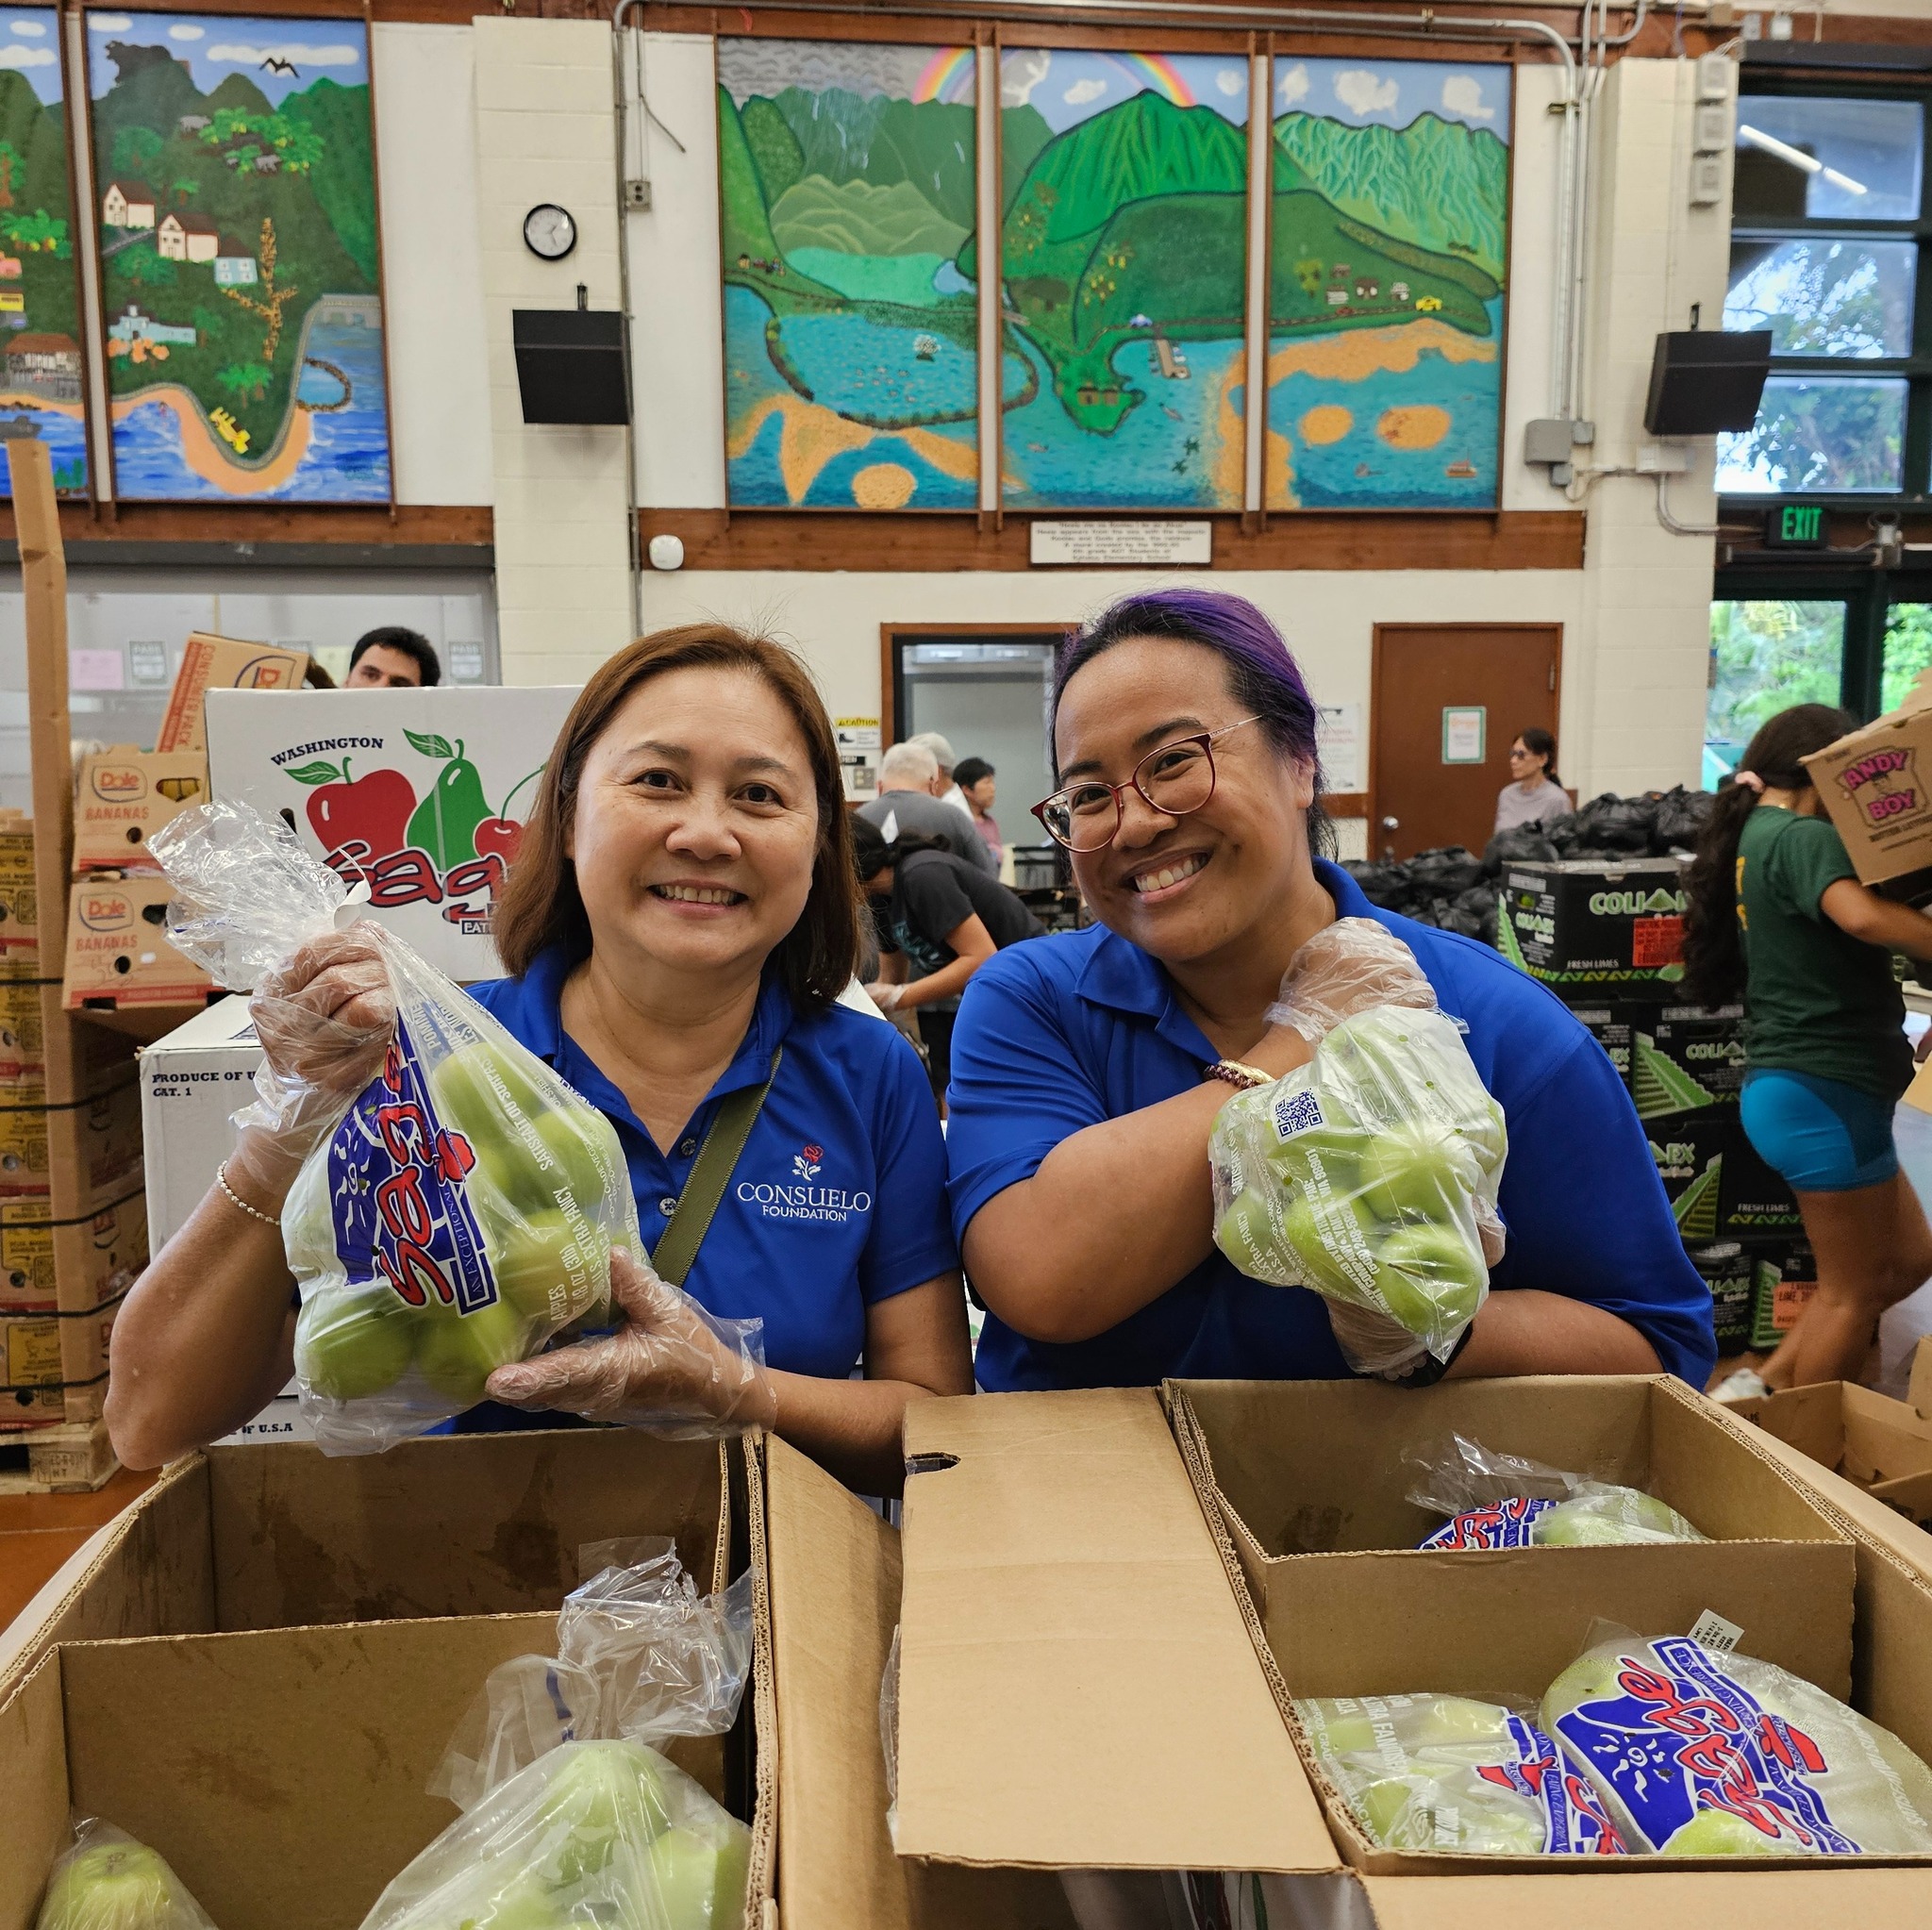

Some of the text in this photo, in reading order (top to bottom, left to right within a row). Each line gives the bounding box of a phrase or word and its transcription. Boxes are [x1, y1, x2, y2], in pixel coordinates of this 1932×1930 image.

[1780, 506, 1823, 542] EXIT
[845, 718, 878, 727] CAUTION
[271, 737, 384, 766] WASHINGTON
[100, 771, 140, 789] Dole
[1843, 750, 1908, 791] ANDY
[85, 806, 150, 822] BANANAS
[1867, 789, 1916, 822] BOY
[88, 900, 126, 918] Dole
[75, 934, 138, 953] BANANAS
[152, 1072, 220, 1084] PRODUCE
[224, 1071, 242, 1081] OF
[153, 1087, 192, 1097] CAT. 1
[1305, 1148, 1326, 1179] 98901
[737, 1182, 872, 1212] CONSUELO
[1303, 1178, 1319, 1201] PAR:
[553, 1186, 582, 1224] FANCY
[762, 1205, 847, 1222] FOUNDATION
[443, 1190, 482, 1275] EXCEPTIONAL
[572, 1220, 597, 1260] EXTRA
[1237, 1211, 1274, 1279] EXTRA FANCY
[559, 1243, 584, 1272] (3lb)
[1265, 1246, 1287, 1277] U.S.A
[570, 1270, 587, 1287] OZ
[548, 1283, 568, 1321] APPLES
[242, 1423, 293, 1434] OF U.S.A
[1618, 1657, 1813, 1846] Sage
